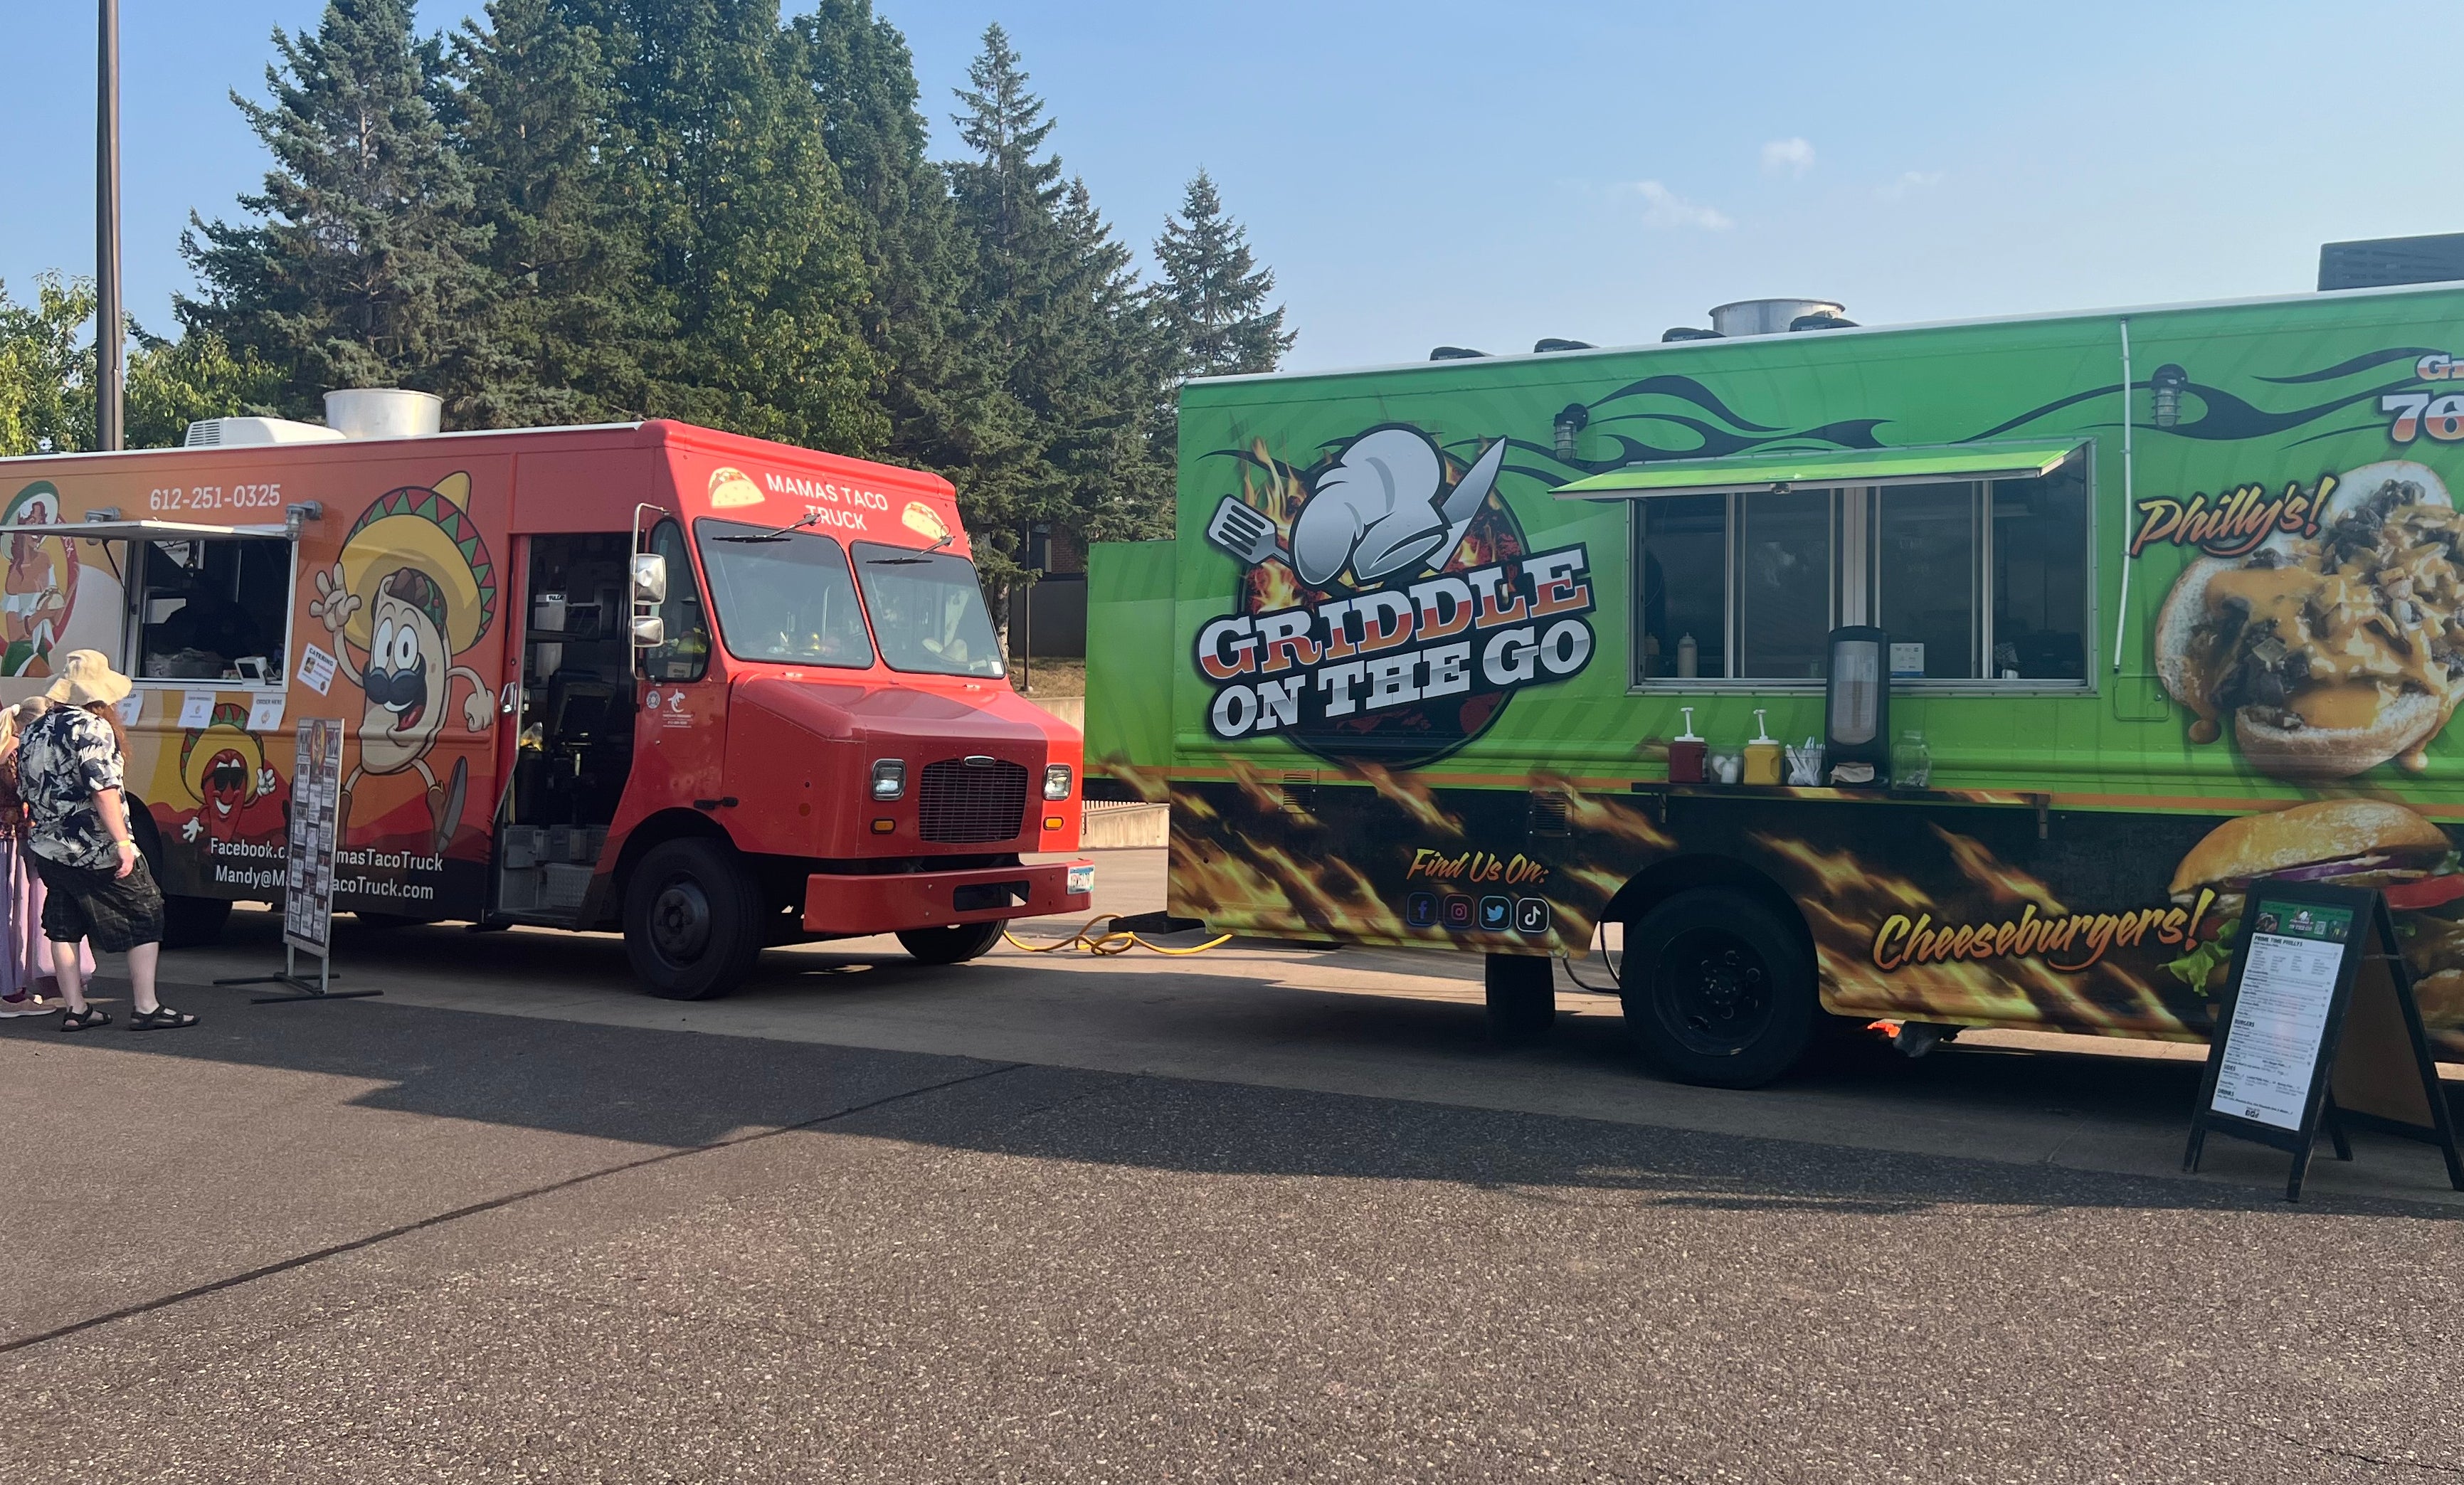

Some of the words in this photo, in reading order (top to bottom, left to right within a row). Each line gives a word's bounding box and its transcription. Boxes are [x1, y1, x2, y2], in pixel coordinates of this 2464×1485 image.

[150, 483, 281, 511] 612-251-0325
[766, 473, 839, 502] MAMAS
[840, 487, 889, 512] TACO
[805, 504, 868, 532] TRUCK
[2130, 475, 2338, 556] Philly's!
[1197, 549, 1590, 680] GRIDDLE
[309, 648, 334, 667] CATERING
[1212, 675, 1306, 737] ON
[1318, 641, 1471, 718] THE
[1482, 619, 1591, 685] GO
[1406, 849, 1470, 879] Find
[1469, 851, 1502, 884] Us
[1504, 852, 1550, 884] On:
[1874, 888, 2216, 971] Cheeseburgers!
